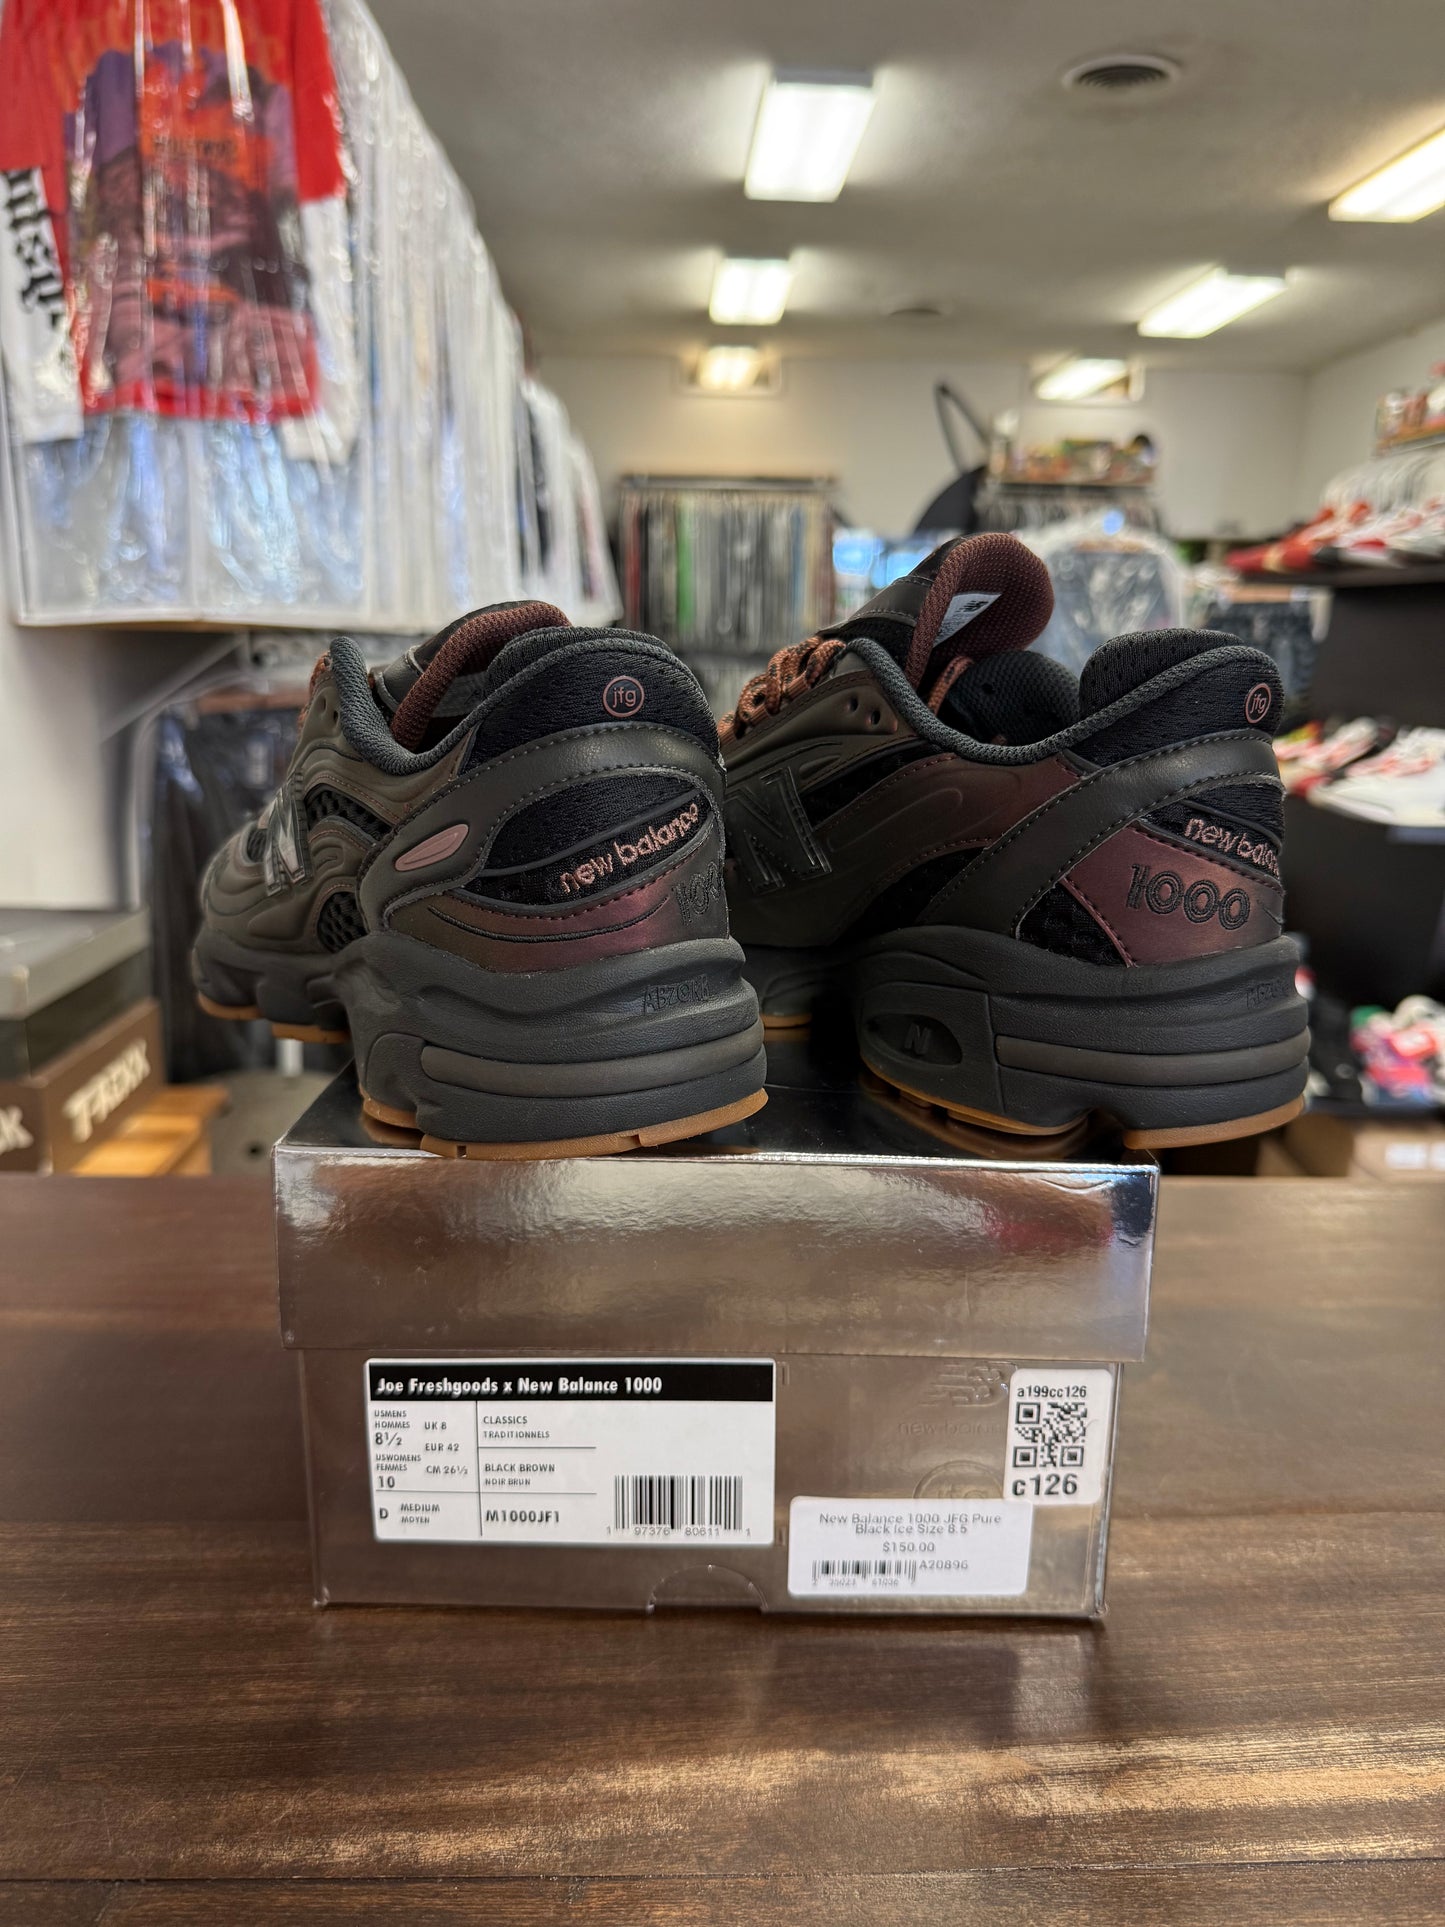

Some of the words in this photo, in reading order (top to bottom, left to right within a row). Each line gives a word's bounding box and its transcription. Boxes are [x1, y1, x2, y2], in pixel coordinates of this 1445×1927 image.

[612, 687, 637, 707] jfg
[1184, 818, 1238, 851] new
[560, 853, 613, 893] new
[1125, 863, 1251, 931] 1000
[376, 1377, 404, 1395] Joe
[407, 1377, 498, 1399] Freshgoods
[501, 1381, 513, 1395] x
[516, 1377, 553, 1394] New
[557, 1376, 618, 1394] Balance
[624, 1376, 663, 1394] 1000
[1016, 1385, 1087, 1398] a199cc126
[374, 1410, 407, 1418] USMENS
[374, 1421, 411, 1429] HOMMES
[424, 1421, 438, 1430] UK
[483, 1416, 528, 1425] CLASSICS
[483, 1430, 550, 1439] TRADITIONNELS
[425, 1443, 444, 1452] EUR
[447, 1443, 460, 1452] 42
[376, 1463, 408, 1471] FEMMES
[426, 1465, 441, 1474] CM
[484, 1463, 516, 1473] BLACK
[519, 1464, 556, 1473] BROWN
[378, 1475, 396, 1489] 10
[485, 1478, 507, 1486] NOIR
[508, 1478, 531, 1486] BRUN
[1011, 1473, 1078, 1497] c126
[379, 1507, 389, 1519] D
[400, 1503, 441, 1512] MEDIUM
[485, 1510, 560, 1523] M1000JF1
[819, 1512, 847, 1524] New
[851, 1512, 903, 1525] Balance
[908, 1513, 940, 1524] 1000
[972, 1513, 1001, 1524] Pure
[634, 1526, 671, 1537] 97376
[684, 1526, 721, 1537] 80611
[855, 1523, 890, 1534] Black
[894, 1524, 913, 1534] Ice
[917, 1524, 944, 1534] Size
[882, 1541, 935, 1553] $150.00
